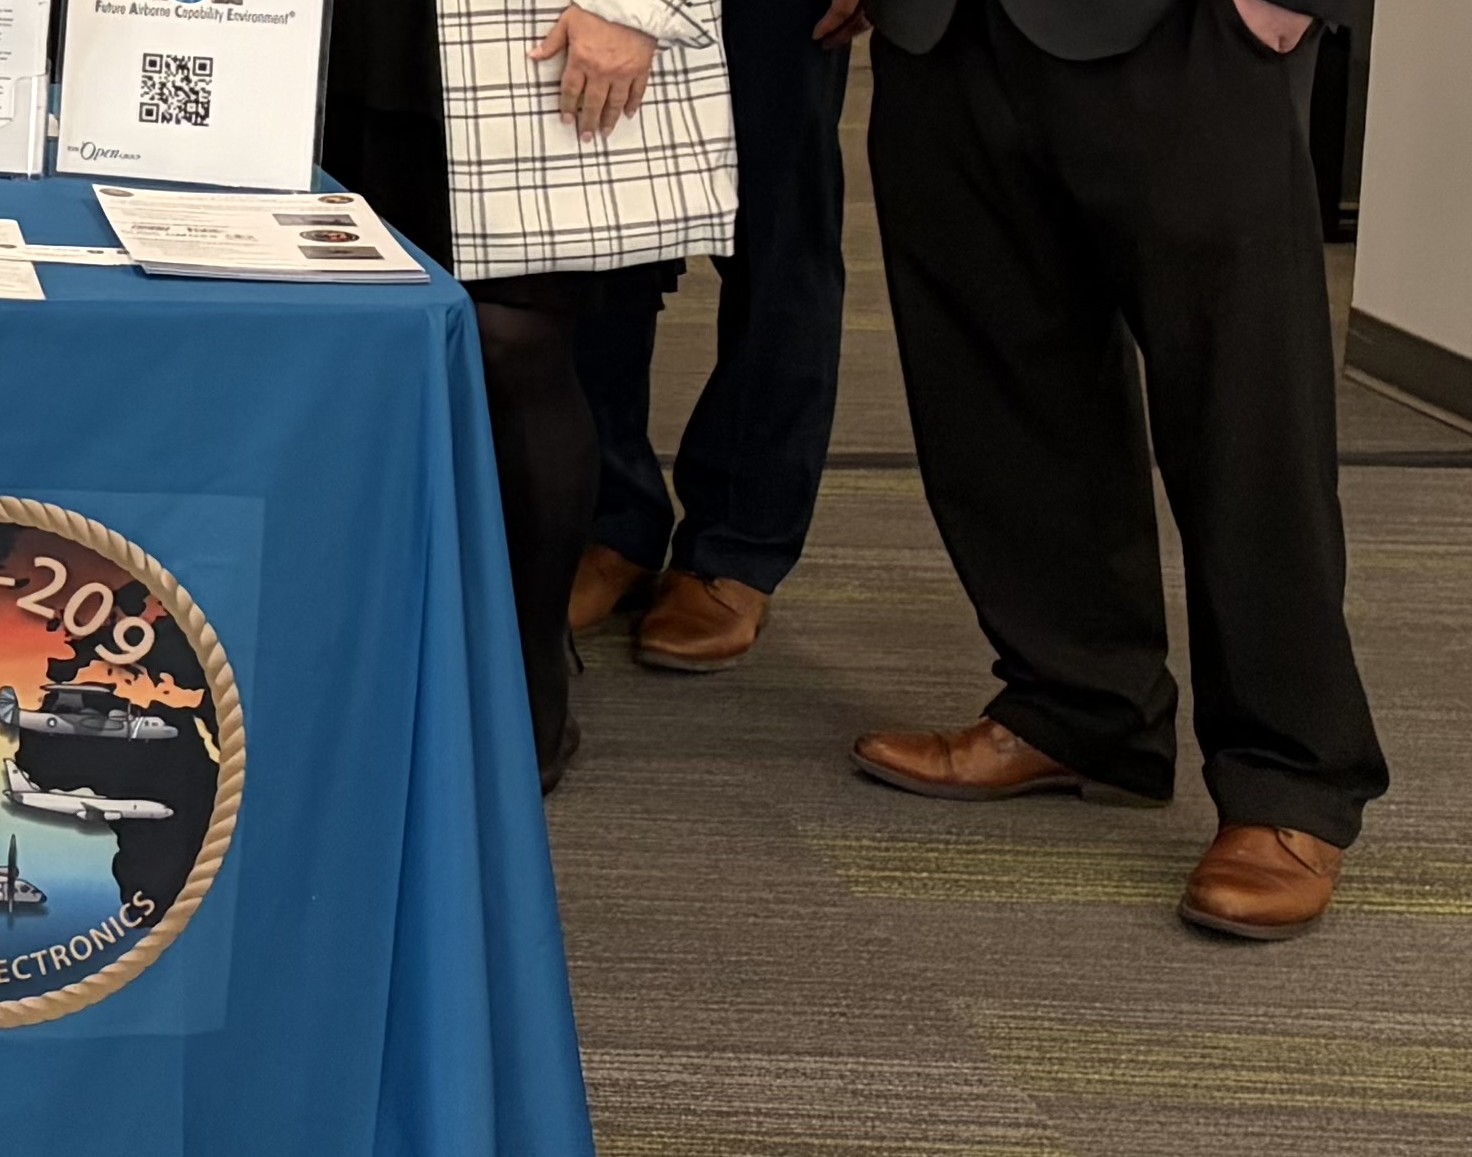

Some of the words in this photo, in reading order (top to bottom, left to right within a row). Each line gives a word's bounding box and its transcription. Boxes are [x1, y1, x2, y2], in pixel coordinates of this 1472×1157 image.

[95, 0, 126, 15] Future
[128, 2, 171, 18] Airborne
[174, 5, 224, 24] Capability
